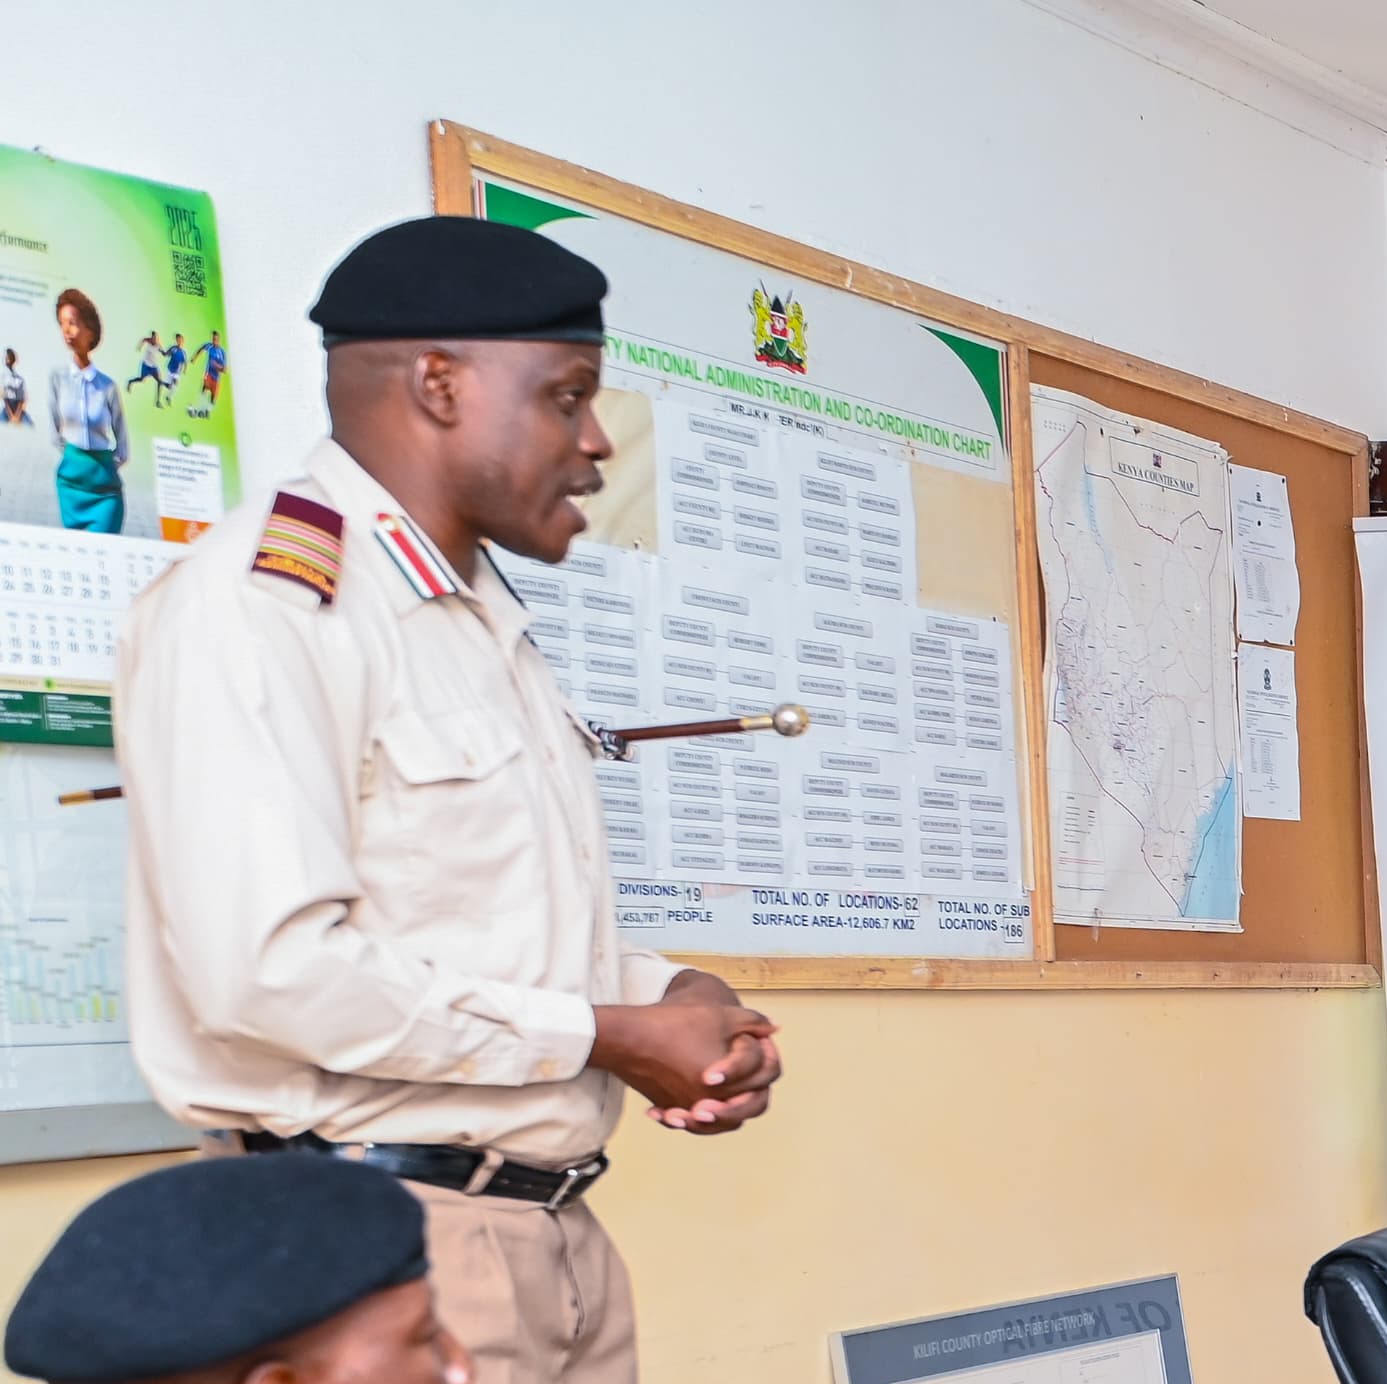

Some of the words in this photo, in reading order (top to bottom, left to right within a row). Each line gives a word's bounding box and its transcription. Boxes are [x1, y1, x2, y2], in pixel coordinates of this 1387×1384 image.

[166, 205, 202, 251] 2025
[627, 343, 702, 381] NATIONAL
[704, 364, 821, 413] ADMINISTRATION
[825, 398, 851, 421] AND
[856, 406, 949, 449] CO-ORDINATION
[952, 433, 991, 460] CHART
[1117, 462, 1144, 479] KENYA
[1144, 469, 1179, 487] COUNTIES
[1180, 478, 1194, 492] MAP
[752, 890, 789, 906] TOTAL
[792, 891, 812, 907] NO.
[815, 892, 830, 907] OF
[667, 910, 713, 922] PEOPLE
[938, 901, 971, 915] TOTAL
[974, 903, 991, 914] NO.
[994, 903, 1008, 916] OF
[1010, 904, 1030, 917] SUB
[752, 912, 808, 927] SURFACE
[893, 918, 915, 930] KM2
[939, 918, 997, 931] LOCATIONS
[913, 1342, 941, 1360] KILIFI
[942, 1333, 982, 1355] COUNTY
[984, 1325, 1023, 1345] OPTICAL
[1025, 1319, 1049, 1337] FIBRE
[1051, 1311, 1095, 1332] NETWORK
